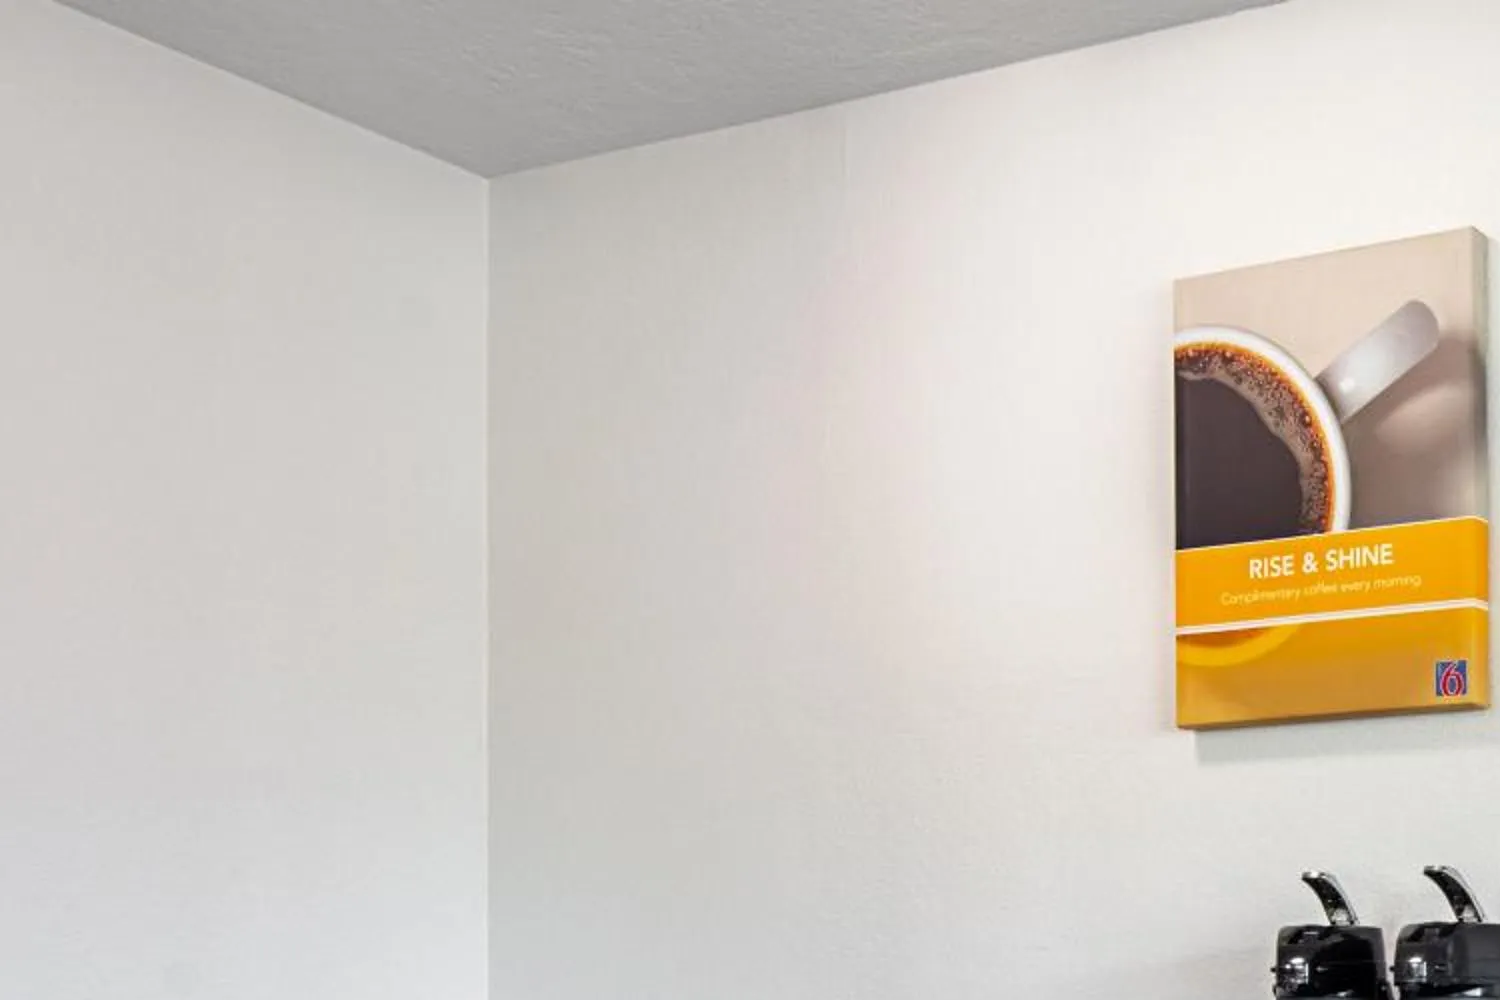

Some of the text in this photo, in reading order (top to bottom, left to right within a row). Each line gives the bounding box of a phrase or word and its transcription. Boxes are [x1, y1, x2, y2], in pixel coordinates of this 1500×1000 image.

[1249, 543, 1394, 579] RISE & SHINE
[1340, 580, 1370, 594] every
[1373, 574, 1422, 590] morning
[1441, 660, 1464, 697] 6
